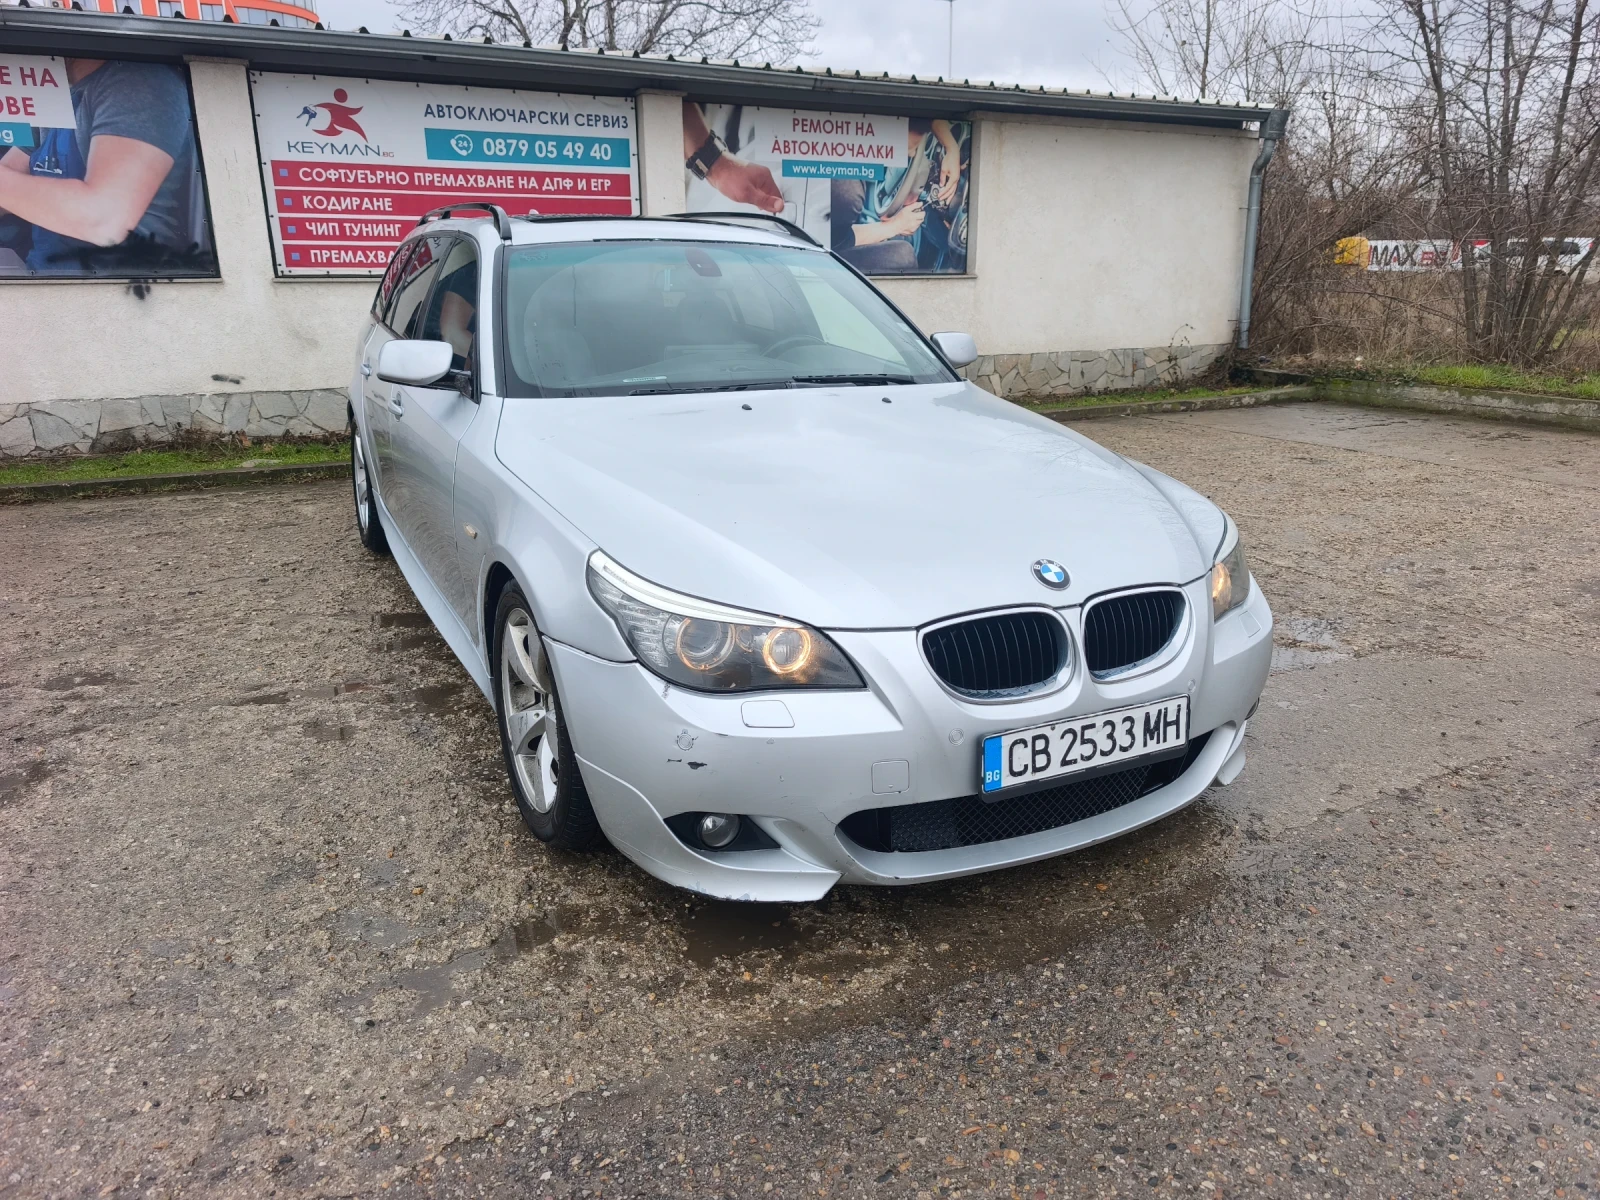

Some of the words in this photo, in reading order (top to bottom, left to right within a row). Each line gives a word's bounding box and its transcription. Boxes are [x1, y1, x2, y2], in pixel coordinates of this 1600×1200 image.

[19, 67, 59, 88] НА
[0, 96, 36, 116] ВЕ
[424, 103, 569, 126] АВТОКЛЮЧАРСКИ
[574, 113, 629, 129] СЕРВИЗ
[0, 129, 14, 144] g
[792, 118, 851, 135] РЕМОНТ
[855, 121, 875, 137] НА
[457, 140, 468, 148] 24
[483, 138, 529, 157] 0879
[534, 141, 557, 159] 05
[563, 142, 584, 160] 49
[590, 143, 612, 161] 40
[771, 138, 894, 160] АВТОКЛЮЧАЛКИ
[299, 167, 409, 185] СОФТУЕЪРНО
[414, 172, 514, 189] ПРЕМАХВАНЕ
[518, 176, 539, 190] НА
[542, 177, 574, 192] ДПФ
[577, 178, 587, 191] И
[591, 178, 612, 191] ЕГР
[792, 162, 875, 179] www.keyman.bg
[302, 195, 393, 211] КОДИРАНЕ
[305, 222, 340, 236] ЧИП
[343, 223, 402, 237] ТУНИНГ
[1008, 733, 1051, 778] CB
[1059, 716, 1136, 768] 2533
[1142, 704, 1182, 748] MH
[985, 768, 1001, 783] BG
